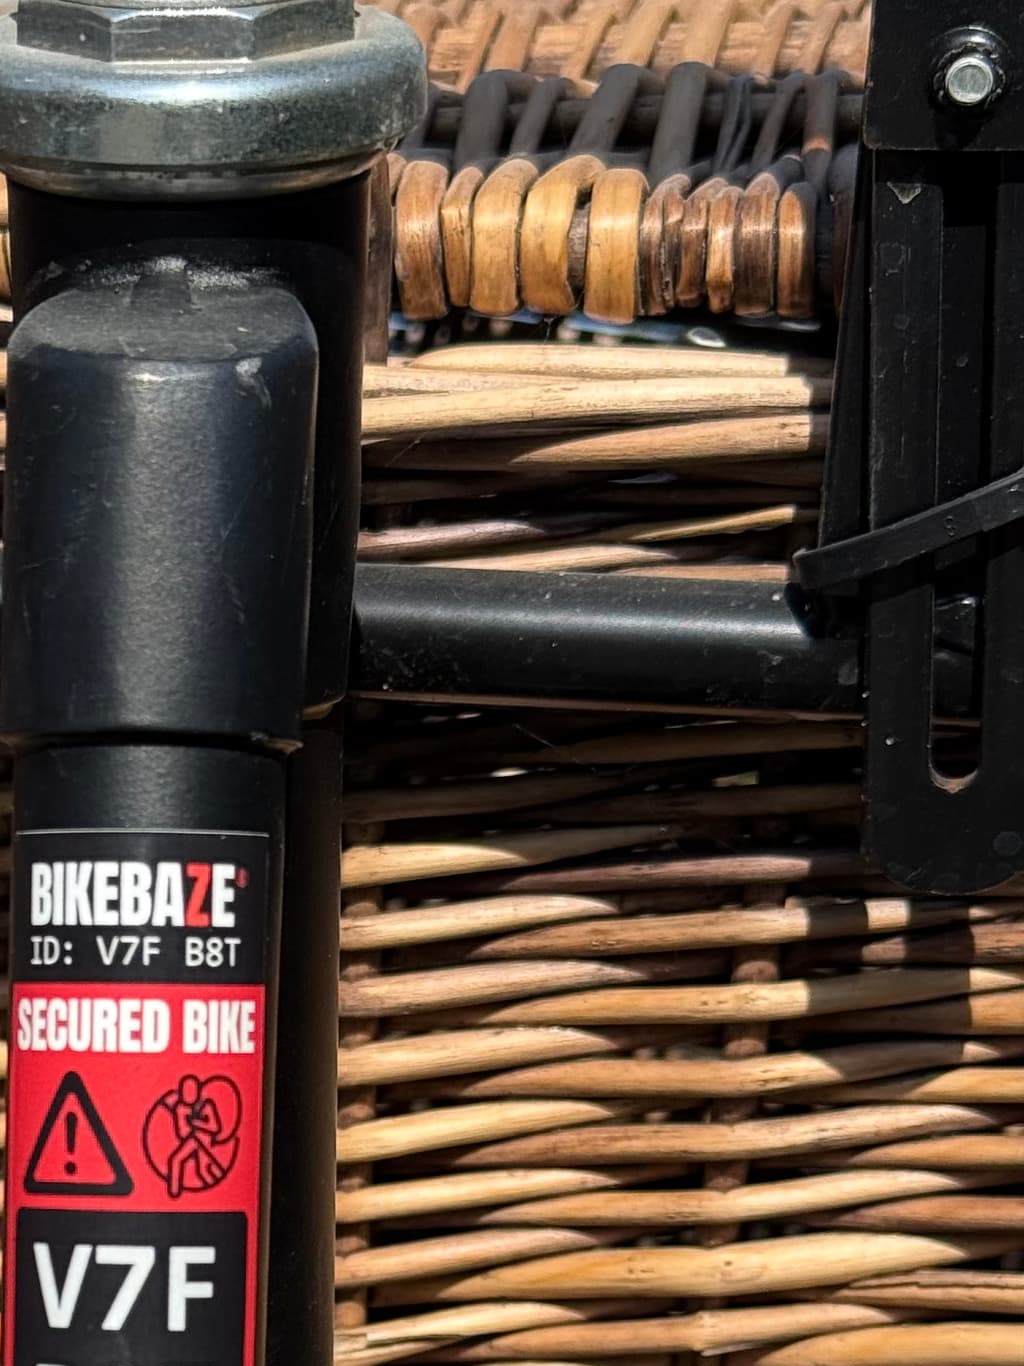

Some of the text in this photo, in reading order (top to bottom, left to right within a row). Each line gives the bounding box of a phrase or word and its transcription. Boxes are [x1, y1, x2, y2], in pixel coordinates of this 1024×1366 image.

[30, 936, 241, 967] ID: V7F B8T
[17, 997, 256, 1054] SECURED BIKE
[33, 1242, 216, 1332] V7F
